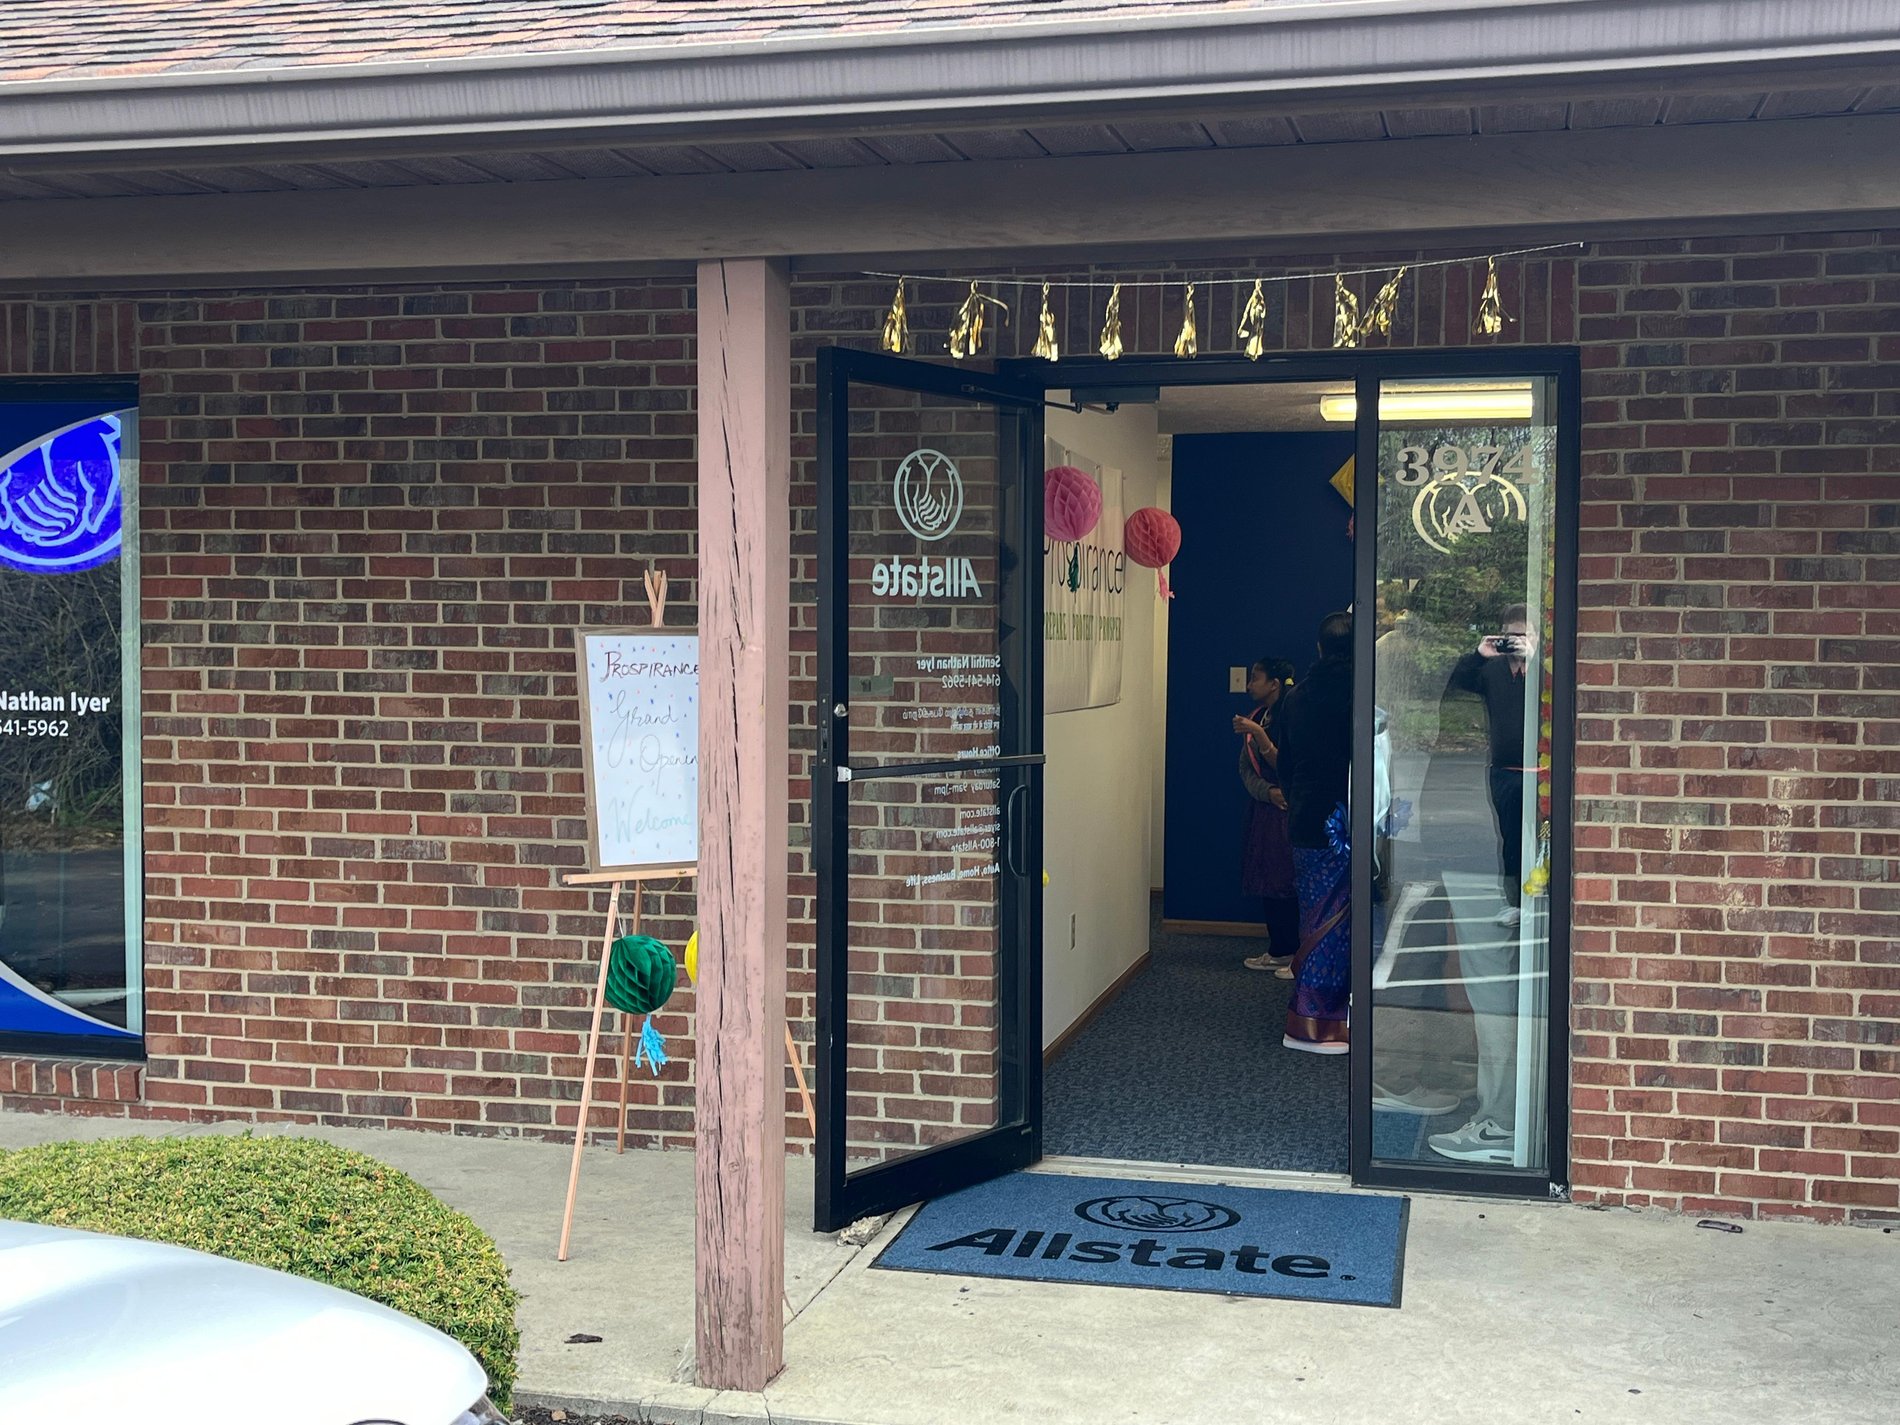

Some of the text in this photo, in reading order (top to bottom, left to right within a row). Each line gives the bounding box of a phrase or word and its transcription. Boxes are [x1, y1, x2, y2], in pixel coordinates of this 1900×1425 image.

[1396, 445, 1539, 487] 3974
[1444, 494, 1491, 533] A
[70, 691, 110, 716] Iyer
[607, 689, 678, 769] Grand
[608, 786, 691, 843] Welcome
[925, 1228, 1331, 1279] Allstate
